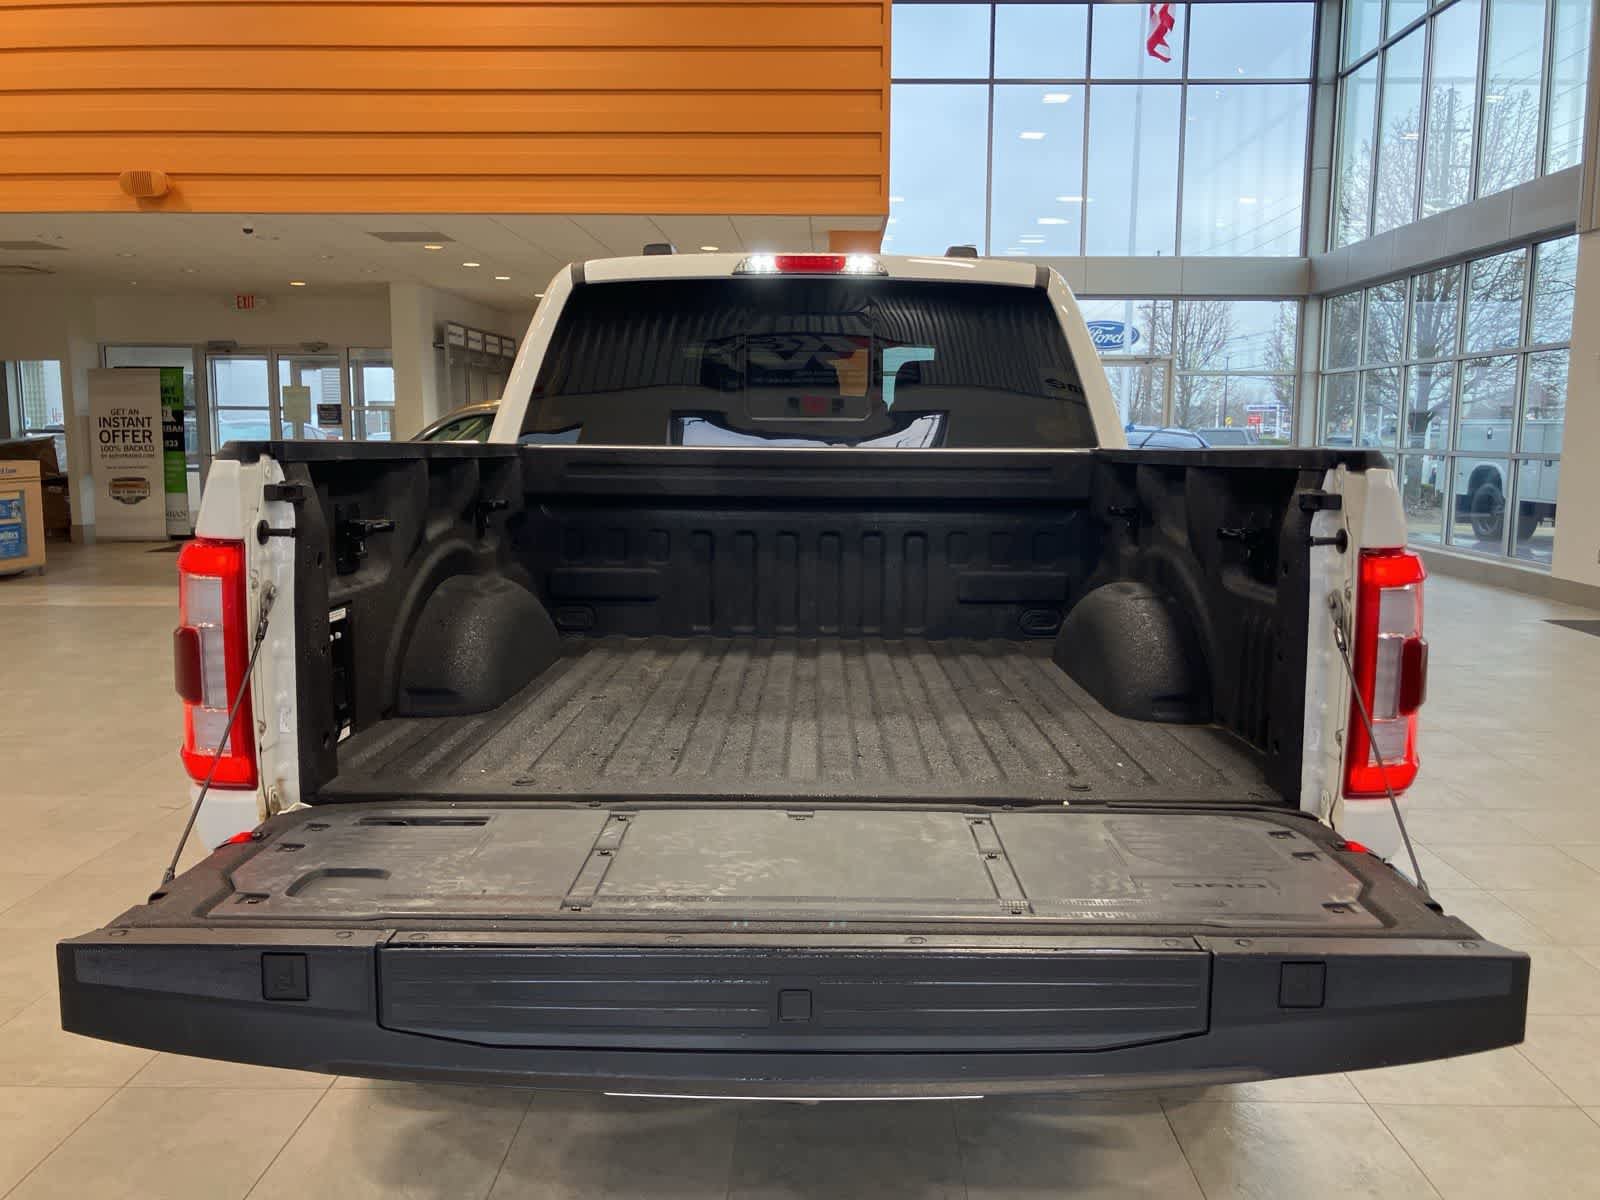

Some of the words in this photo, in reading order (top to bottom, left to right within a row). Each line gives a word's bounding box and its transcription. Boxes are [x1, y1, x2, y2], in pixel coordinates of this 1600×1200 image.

[237, 295, 254, 309] EXIT
[1088, 325, 1123, 344] Ford
[110, 408, 126, 416] GET
[127, 408, 139, 416] AN
[98, 416, 152, 428] INSTANT
[98, 429, 152, 444] OFFER
[123, 444, 155, 452] BACKED
